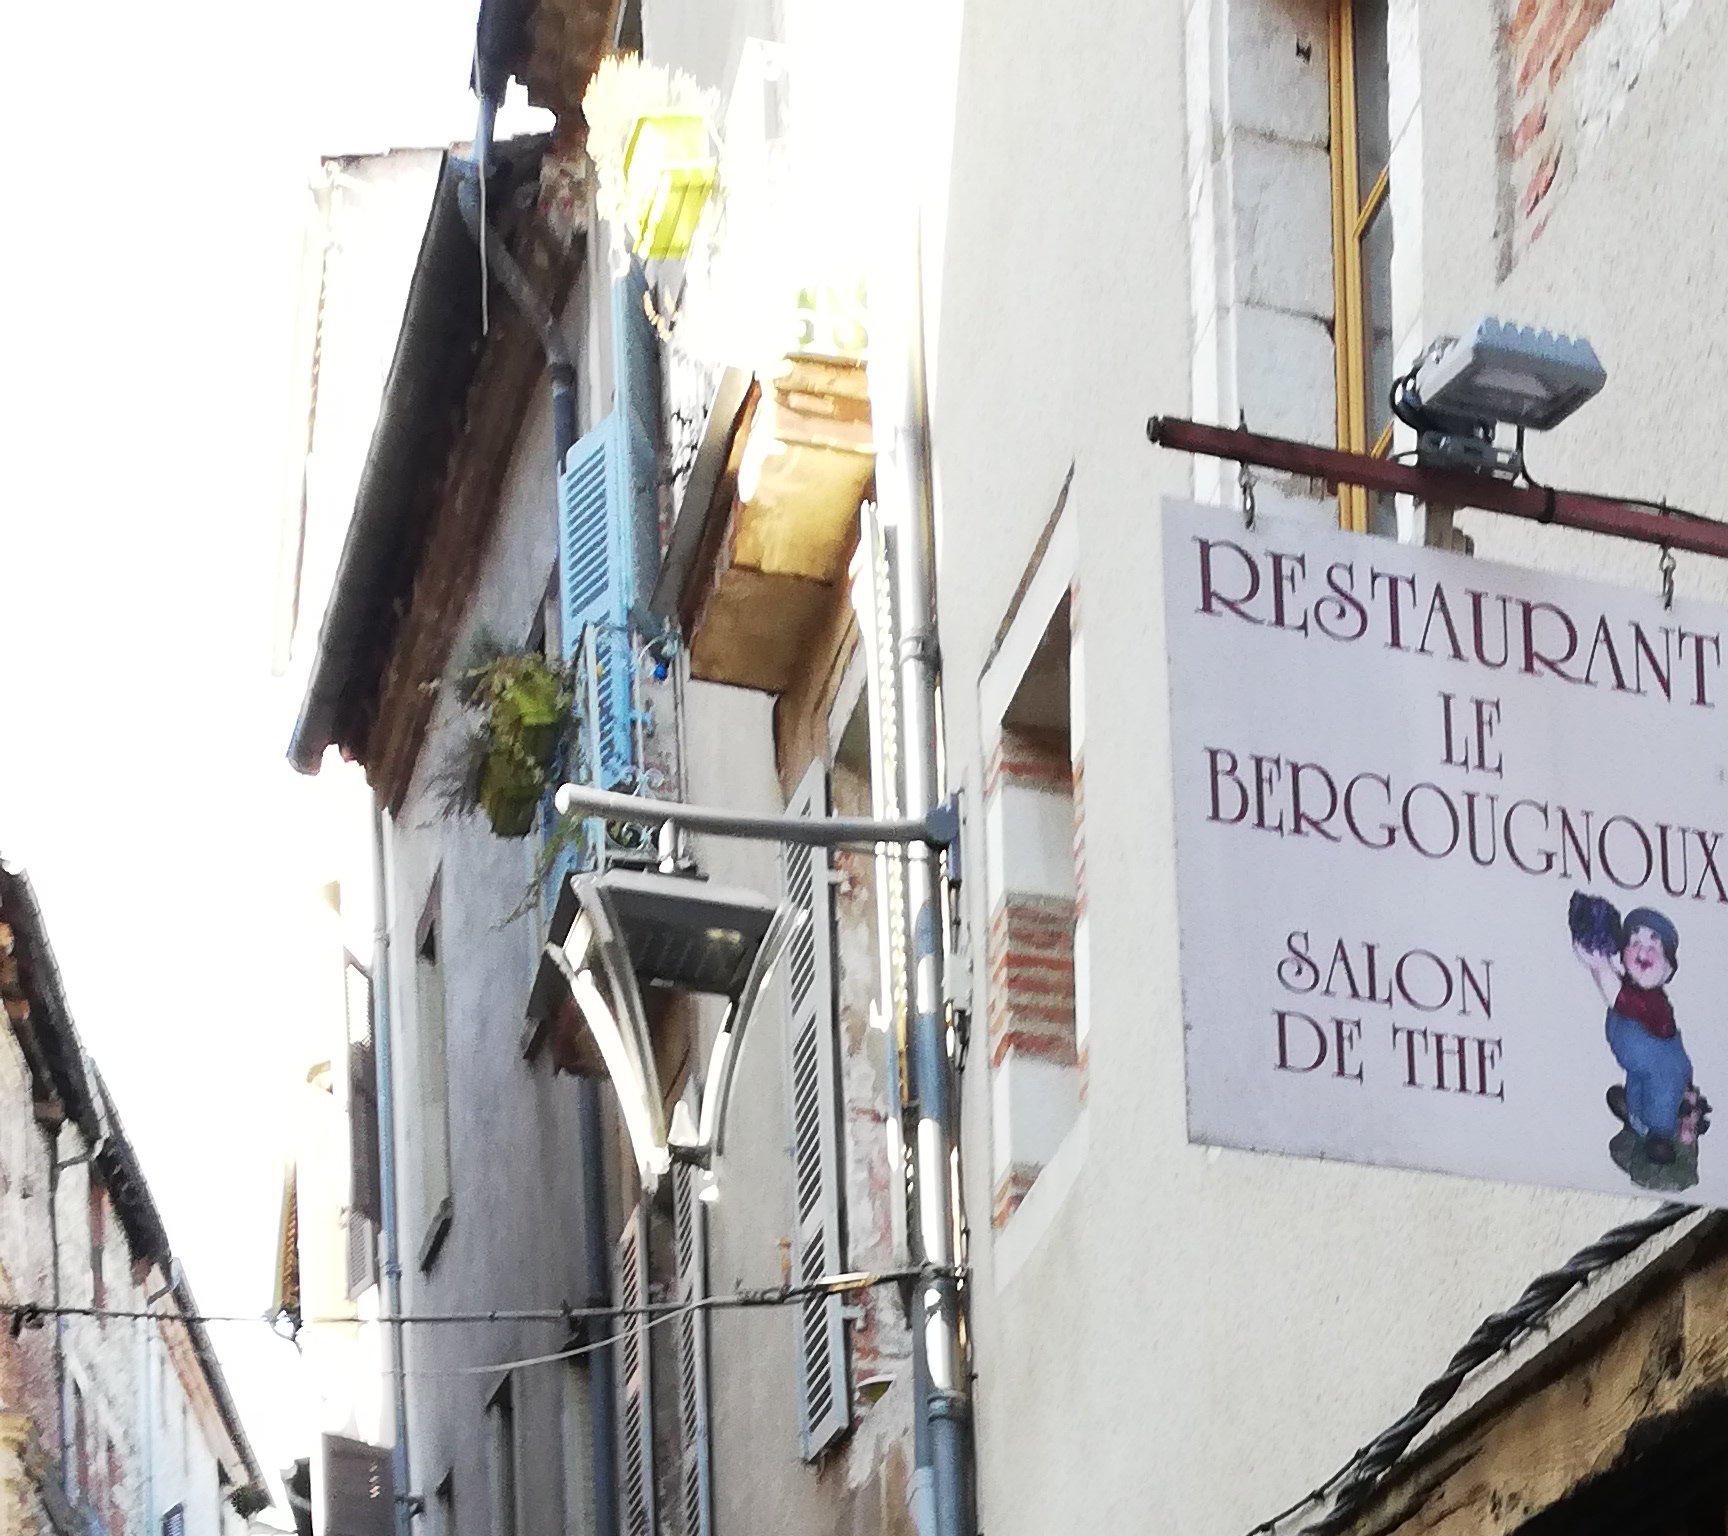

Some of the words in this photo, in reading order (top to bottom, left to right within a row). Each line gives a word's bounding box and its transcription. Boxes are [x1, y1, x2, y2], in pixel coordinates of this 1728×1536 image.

[1193, 536, 1721, 708] RESTAURANT
[1437, 691, 1504, 778] LE
[1276, 929, 1496, 1020] SALON
[1271, 1009, 1364, 1084] DE
[1392, 1023, 1505, 1102] THE
